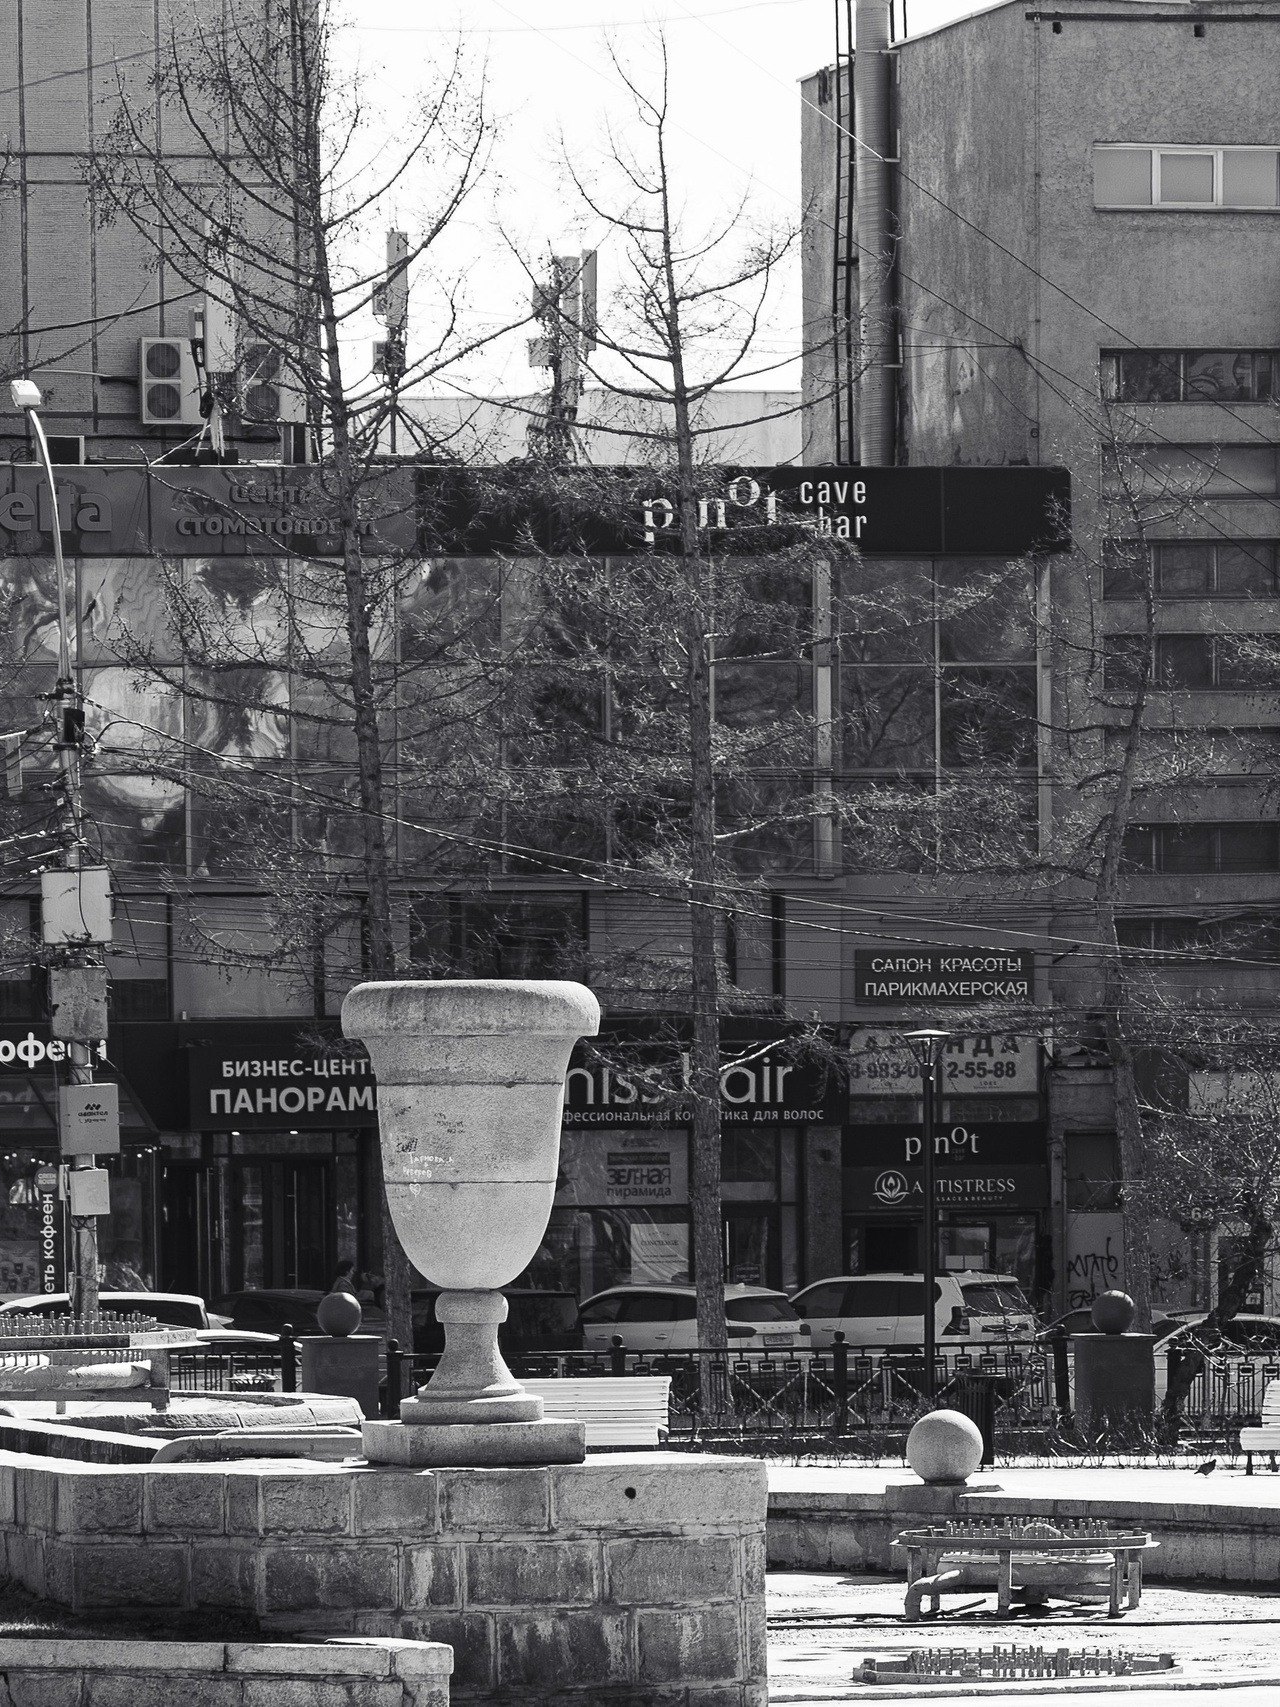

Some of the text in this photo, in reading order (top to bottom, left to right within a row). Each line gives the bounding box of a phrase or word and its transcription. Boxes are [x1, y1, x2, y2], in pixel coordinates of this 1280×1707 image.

[800, 480, 867, 504] cave
[642, 475, 783, 543] pnot
[871, 957, 1022, 973] САЛОН КРАСОТЫ
[865, 982, 1028, 996] ПАРИКМАХЕРСКАЯ
[222, 1059, 375, 1079] БИЗНЕС-ЦЕНТ
[210, 1086, 378, 1114] ПАНОРАМ
[753, 1110, 779, 1122] для
[783, 1109, 825, 1121] волос
[904, 1126, 980, 1161] pnot
[607, 1187, 671, 1200] пирамида
[911, 1178, 1016, 1193] ATISTRESS
[39, 1194, 58, 1259] кофеен
